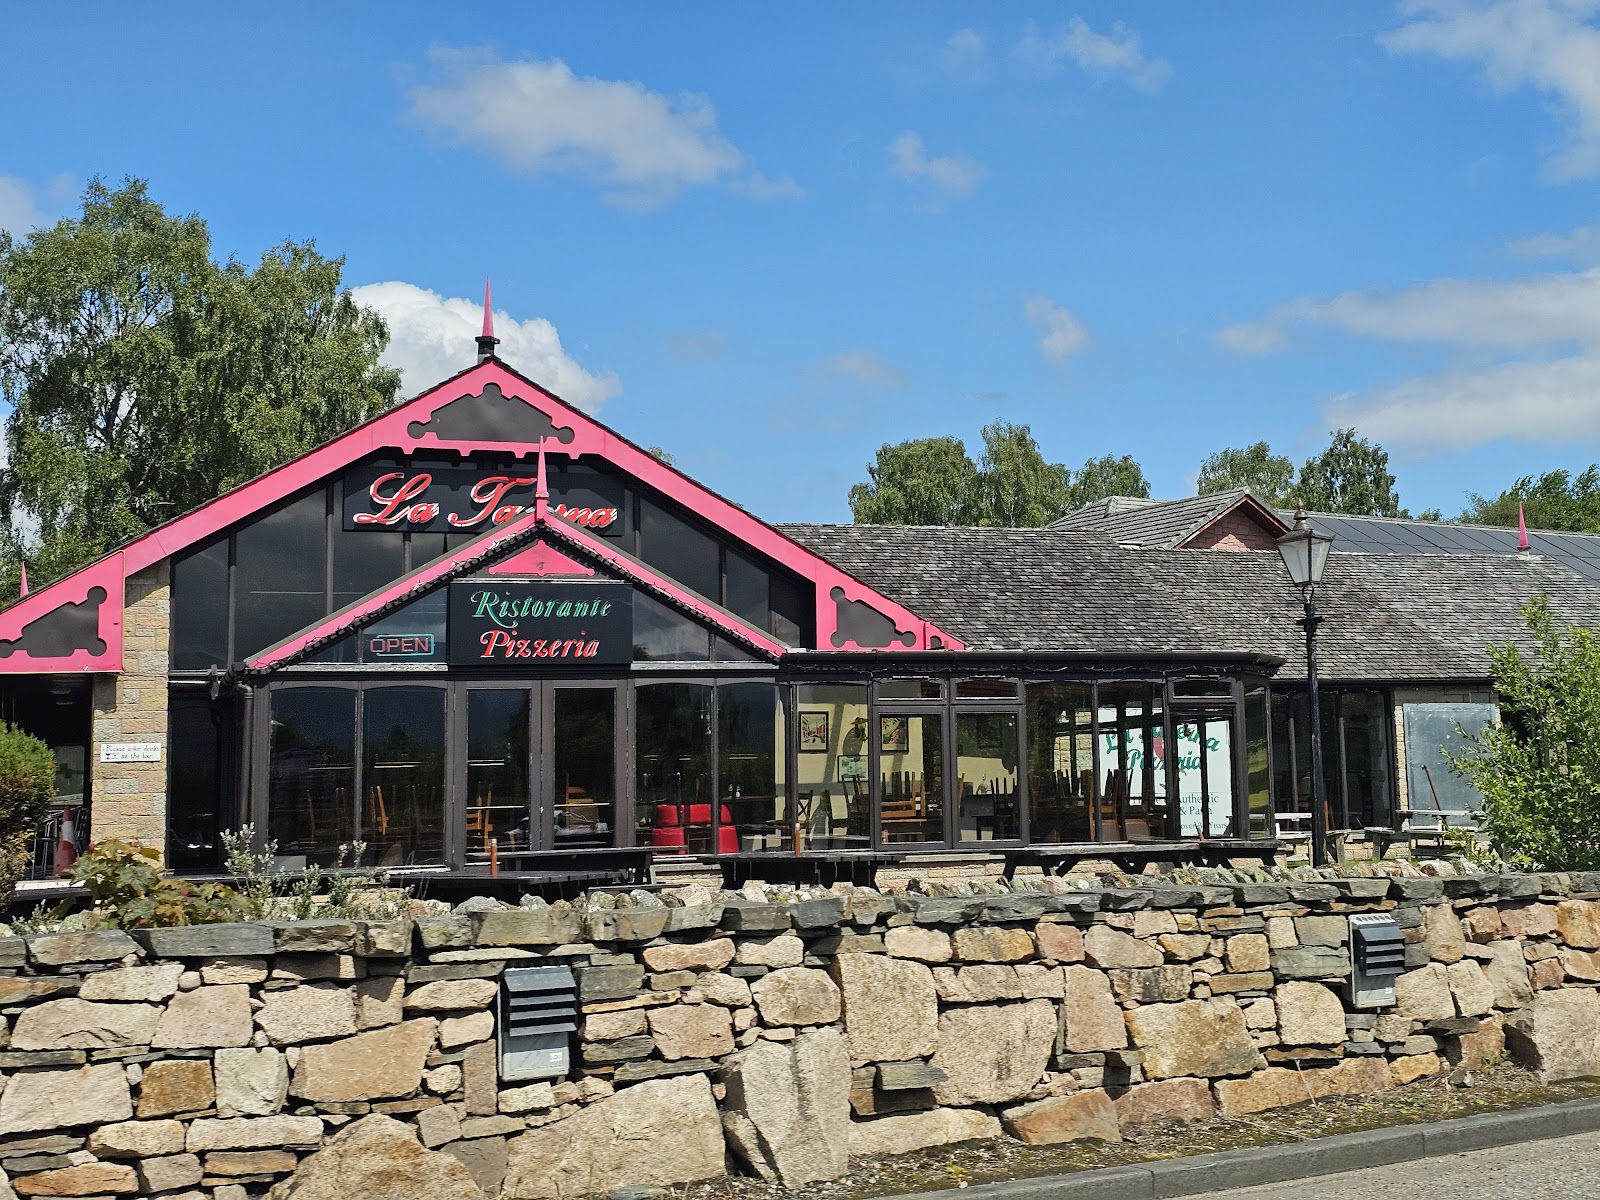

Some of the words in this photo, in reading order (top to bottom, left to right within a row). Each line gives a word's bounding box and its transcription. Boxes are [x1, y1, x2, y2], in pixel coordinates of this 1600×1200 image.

[353, 472, 440, 526] La
[447, 475, 618, 529] Tarna
[470, 590, 613, 628] Ristorante
[369, 637, 429, 653] OPEN
[479, 629, 600, 659] Pizzeria
[143, 744, 160, 752] drinks
